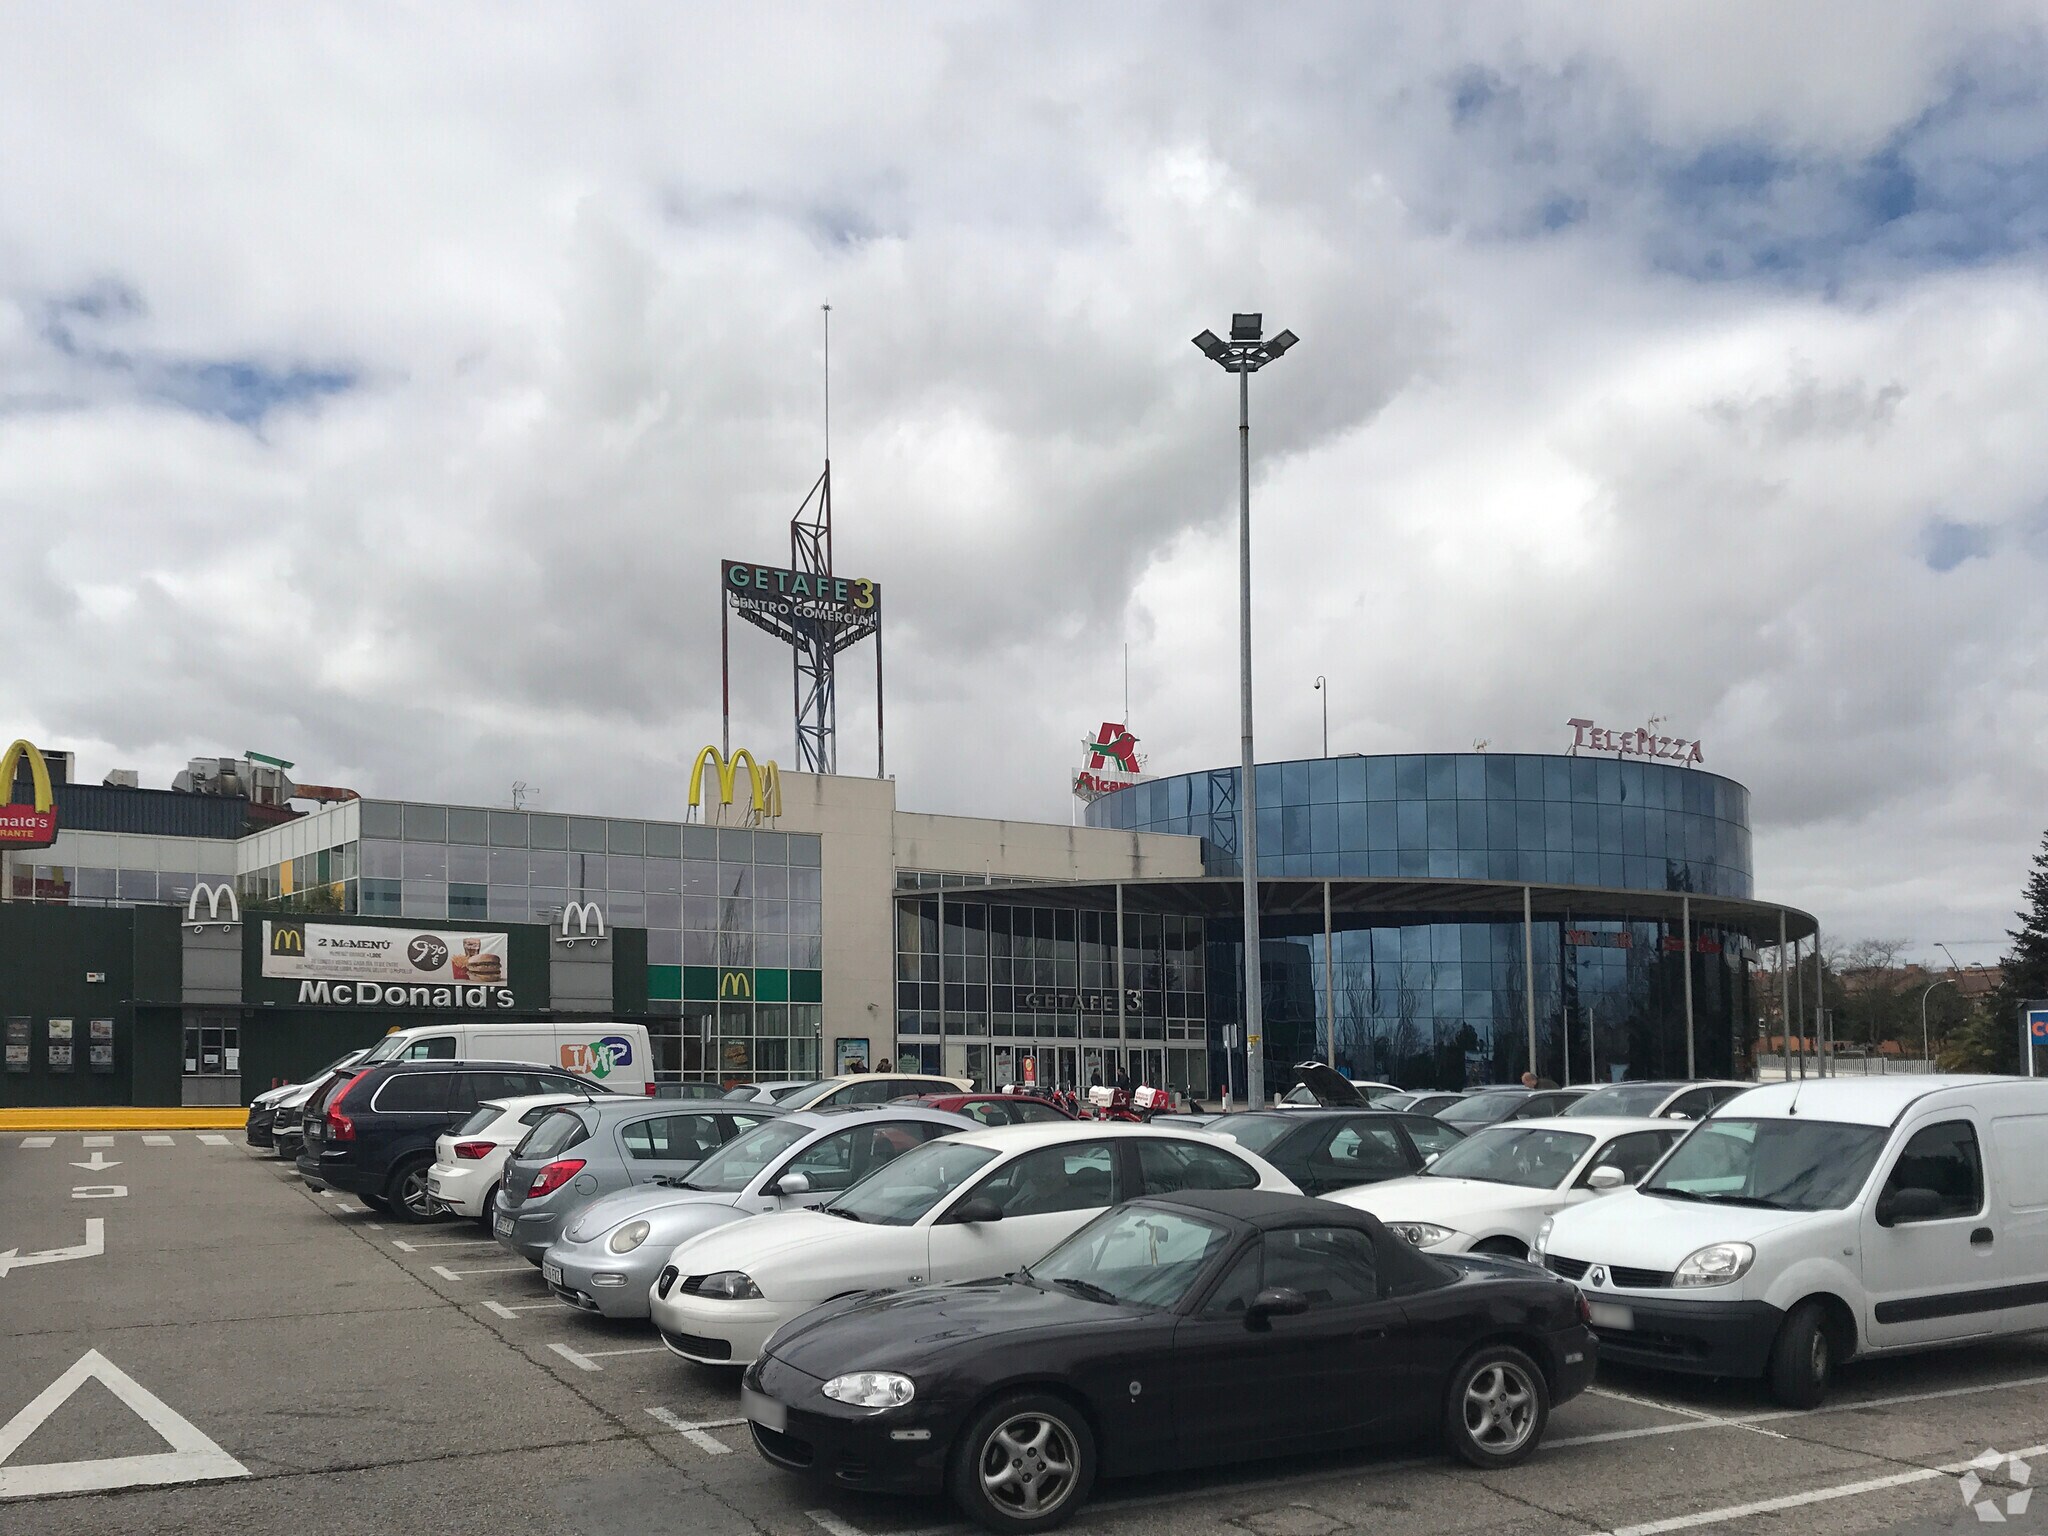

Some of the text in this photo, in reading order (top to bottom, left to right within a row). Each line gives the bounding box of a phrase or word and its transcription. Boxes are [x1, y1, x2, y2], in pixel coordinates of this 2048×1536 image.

[728, 565, 875, 609] GETAFE 3
[729, 595, 876, 627] CENTRO COMERCIAL
[318, 938, 327, 947] 2
[298, 980, 515, 1008] McDonald's
[1025, 989, 1142, 1012] GETAFE 3
[2032, 1021, 2048, 1037] C
